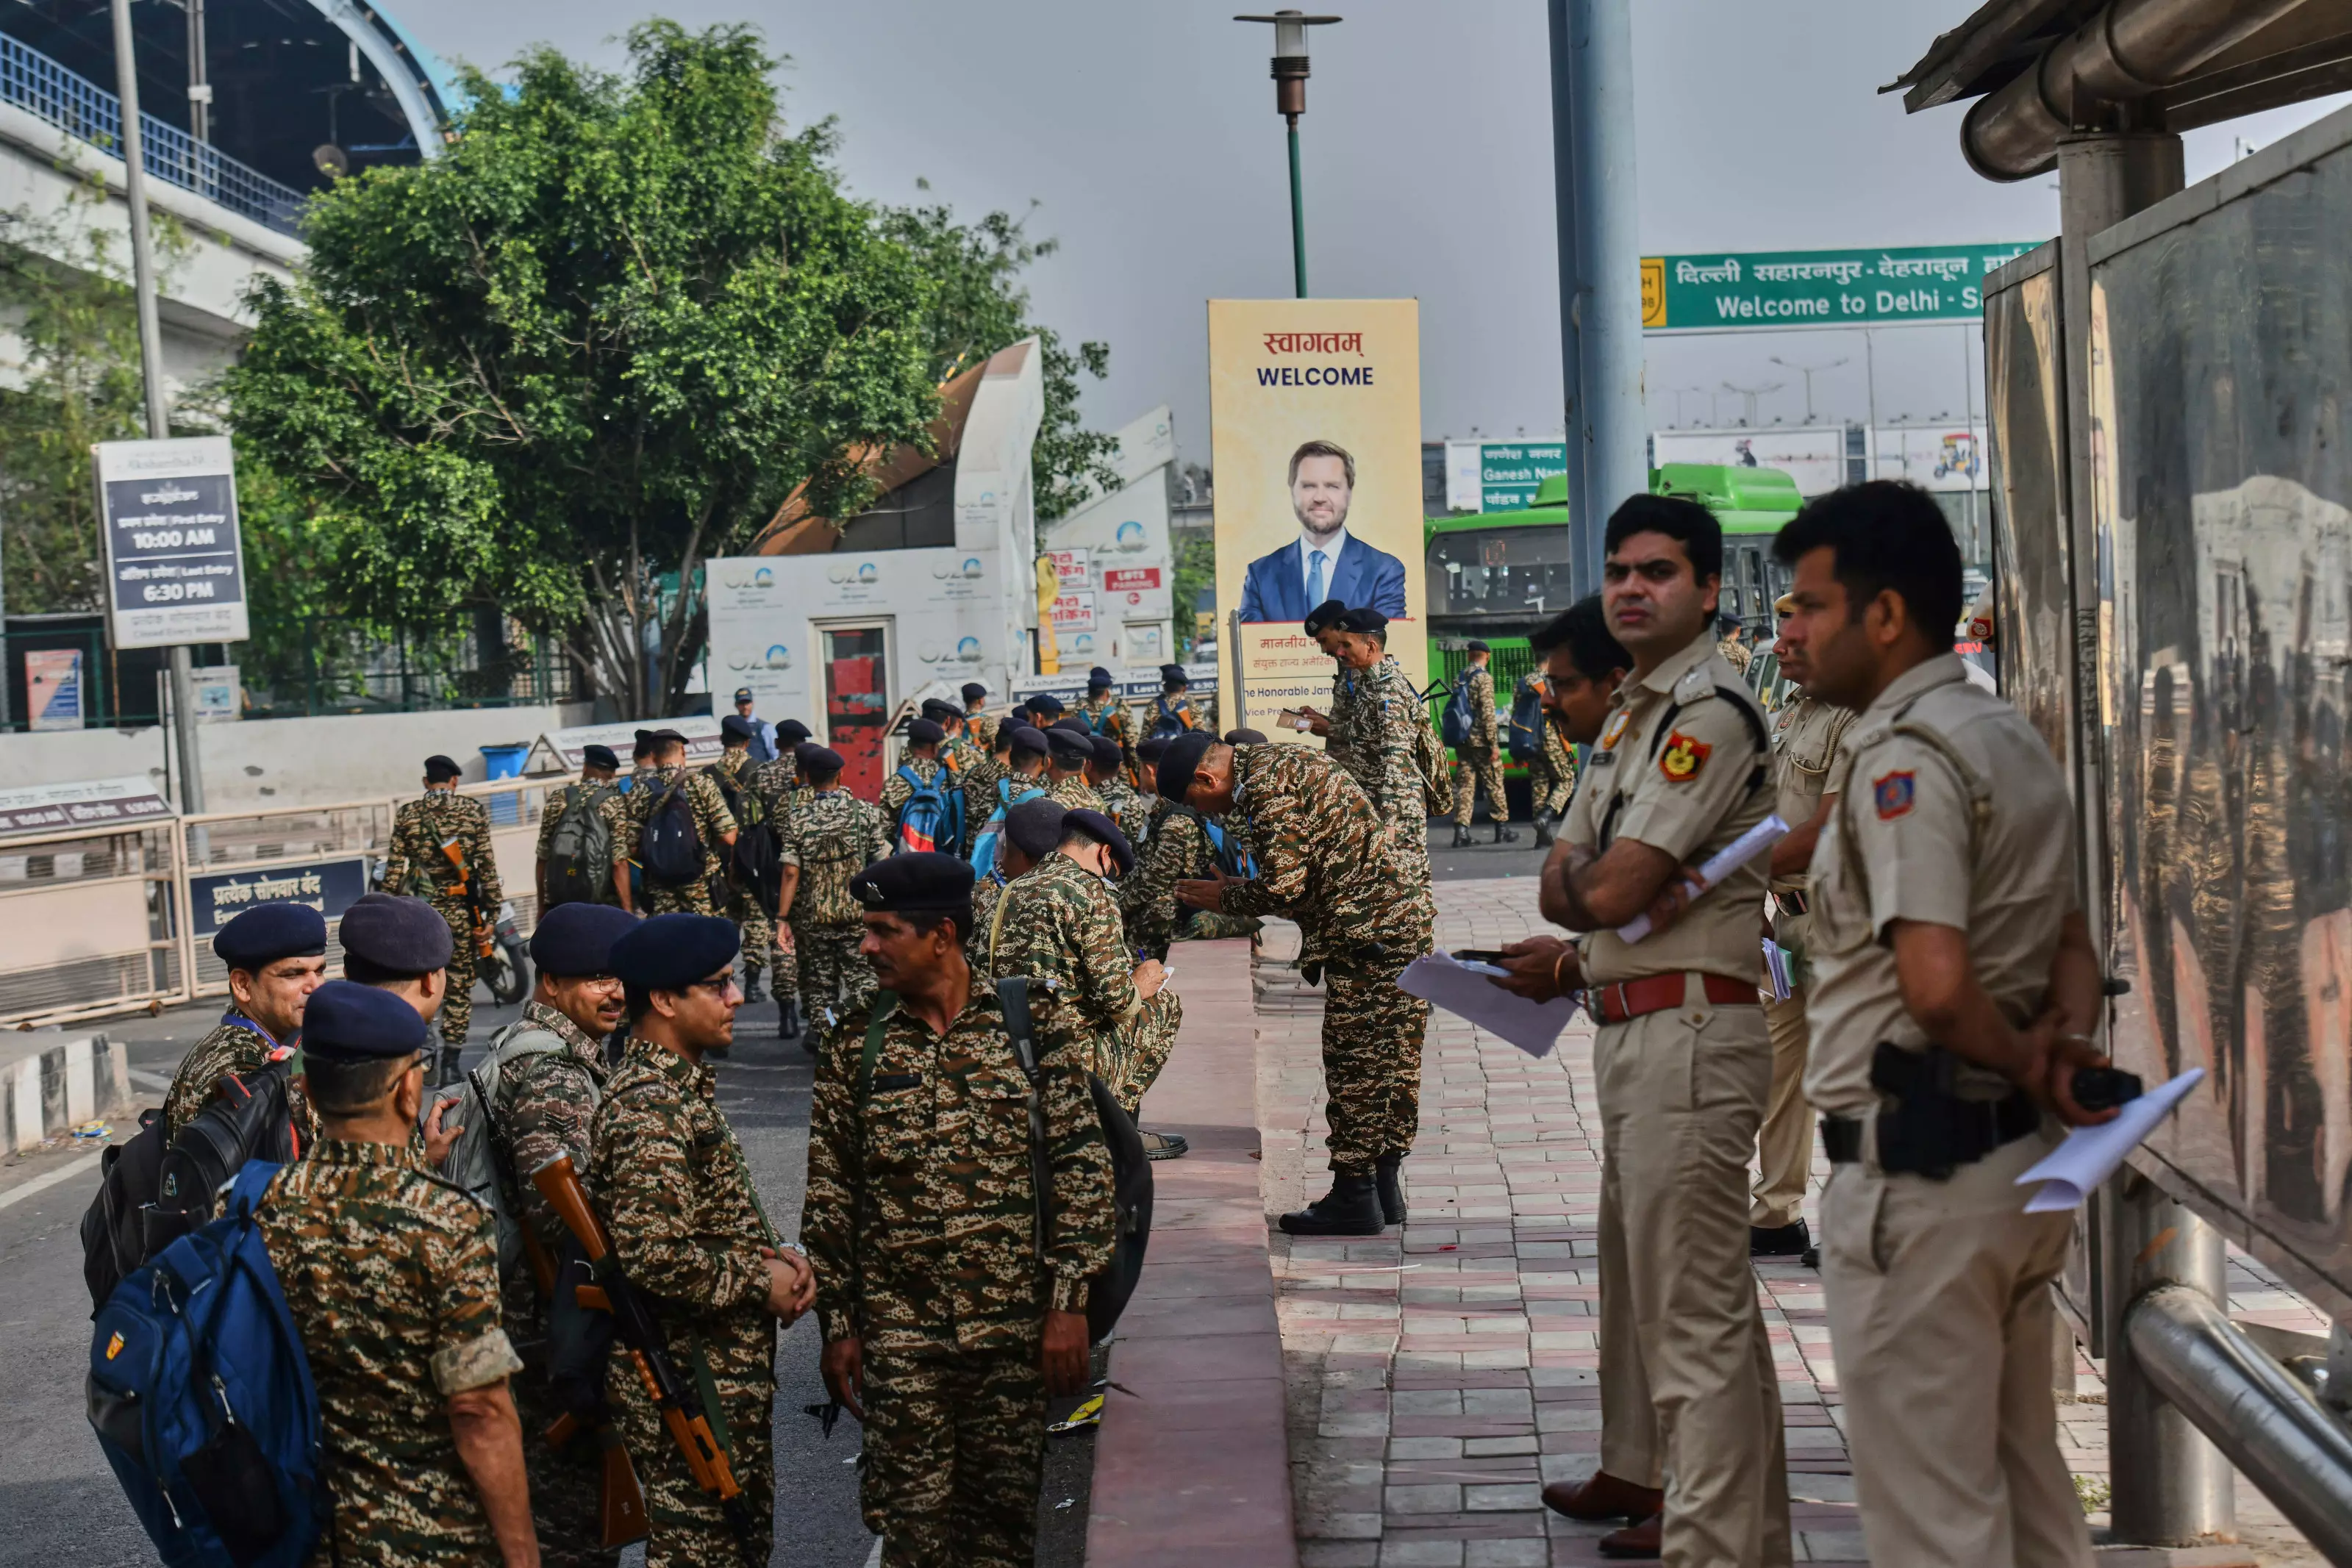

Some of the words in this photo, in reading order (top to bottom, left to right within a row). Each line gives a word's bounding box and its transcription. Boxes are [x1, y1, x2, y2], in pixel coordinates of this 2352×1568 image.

[1676, 259, 1740, 284] दिल्ली
[1753, 261, 1863, 285] सहारनपुर
[1878, 254, 1969, 281] देहरादून
[1716, 296, 1830, 318] Welcome
[1840, 293, 1865, 314] to
[1876, 289, 1940, 313] Delhi
[1263, 333, 1365, 357] स्वागतम्
[1257, 368, 1373, 386] WELCOME
[1528, 448, 1562, 459] नगर
[1484, 468, 1531, 481] Ganesh
[132, 531, 182, 549] 10:00
[185, 529, 215, 546] AM
[143, 583, 183, 602] 6:30
[185, 581, 214, 599] PM
[1260, 635, 1307, 649] माननीय
[1254, 658, 1277, 670] संयुक्त
[1280, 659, 1299, 668] राज्य
[1130, 671, 1161, 679] Tuesd
[1257, 687, 1309, 697] Honorable
[1312, 686, 1334, 695] Jam
[1245, 708, 1265, 716] Vice
[212, 878, 252, 906] प्रत्येक
[253, 873, 299, 901] सोमवार
[299, 870, 321, 895] बंद
